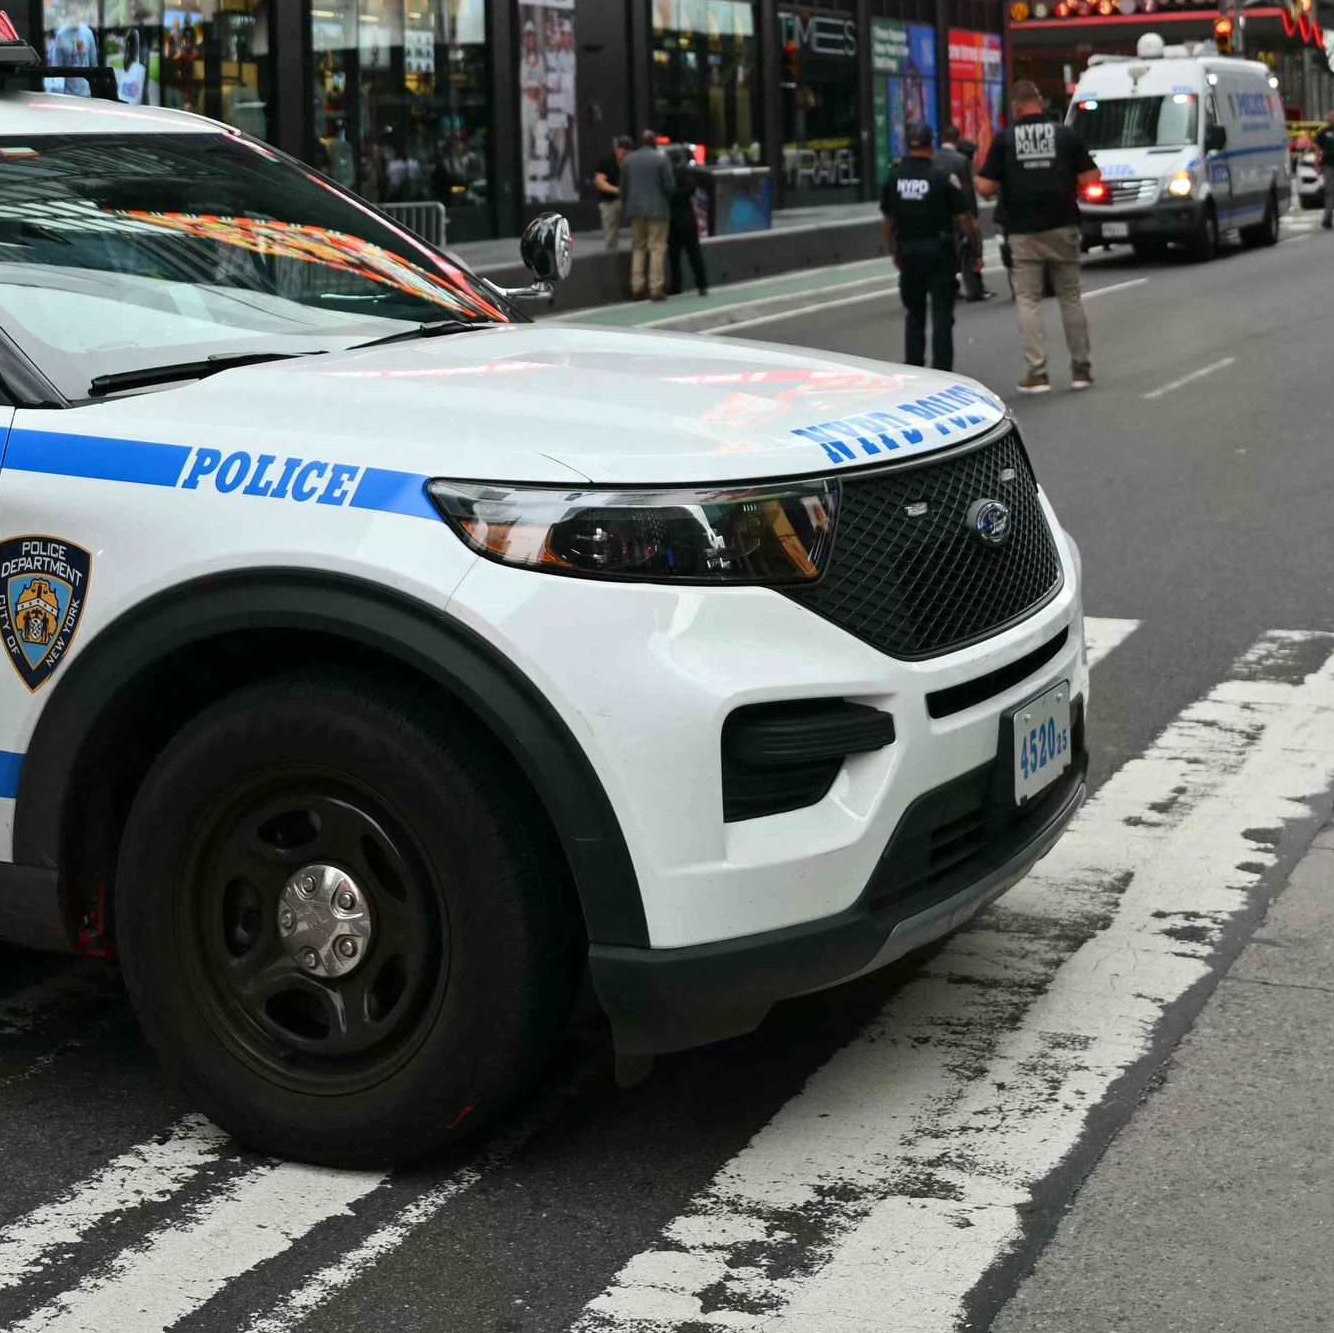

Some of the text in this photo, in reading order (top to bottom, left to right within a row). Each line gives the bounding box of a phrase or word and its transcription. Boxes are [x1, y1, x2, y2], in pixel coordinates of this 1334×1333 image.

[1015, 122, 1055, 141] NYPD
[1016, 138, 1056, 154] POLICE
[897, 178, 930, 194] NYPD
[790, 411, 924, 465] NYPD
[181, 447, 361, 507] POLICE
[21, 541, 67, 561] POLICE
[0, 557, 83, 587] DEPARTMENT
[46, 598, 80, 668] NEW YORK
[6, 635, 21, 657] OF
